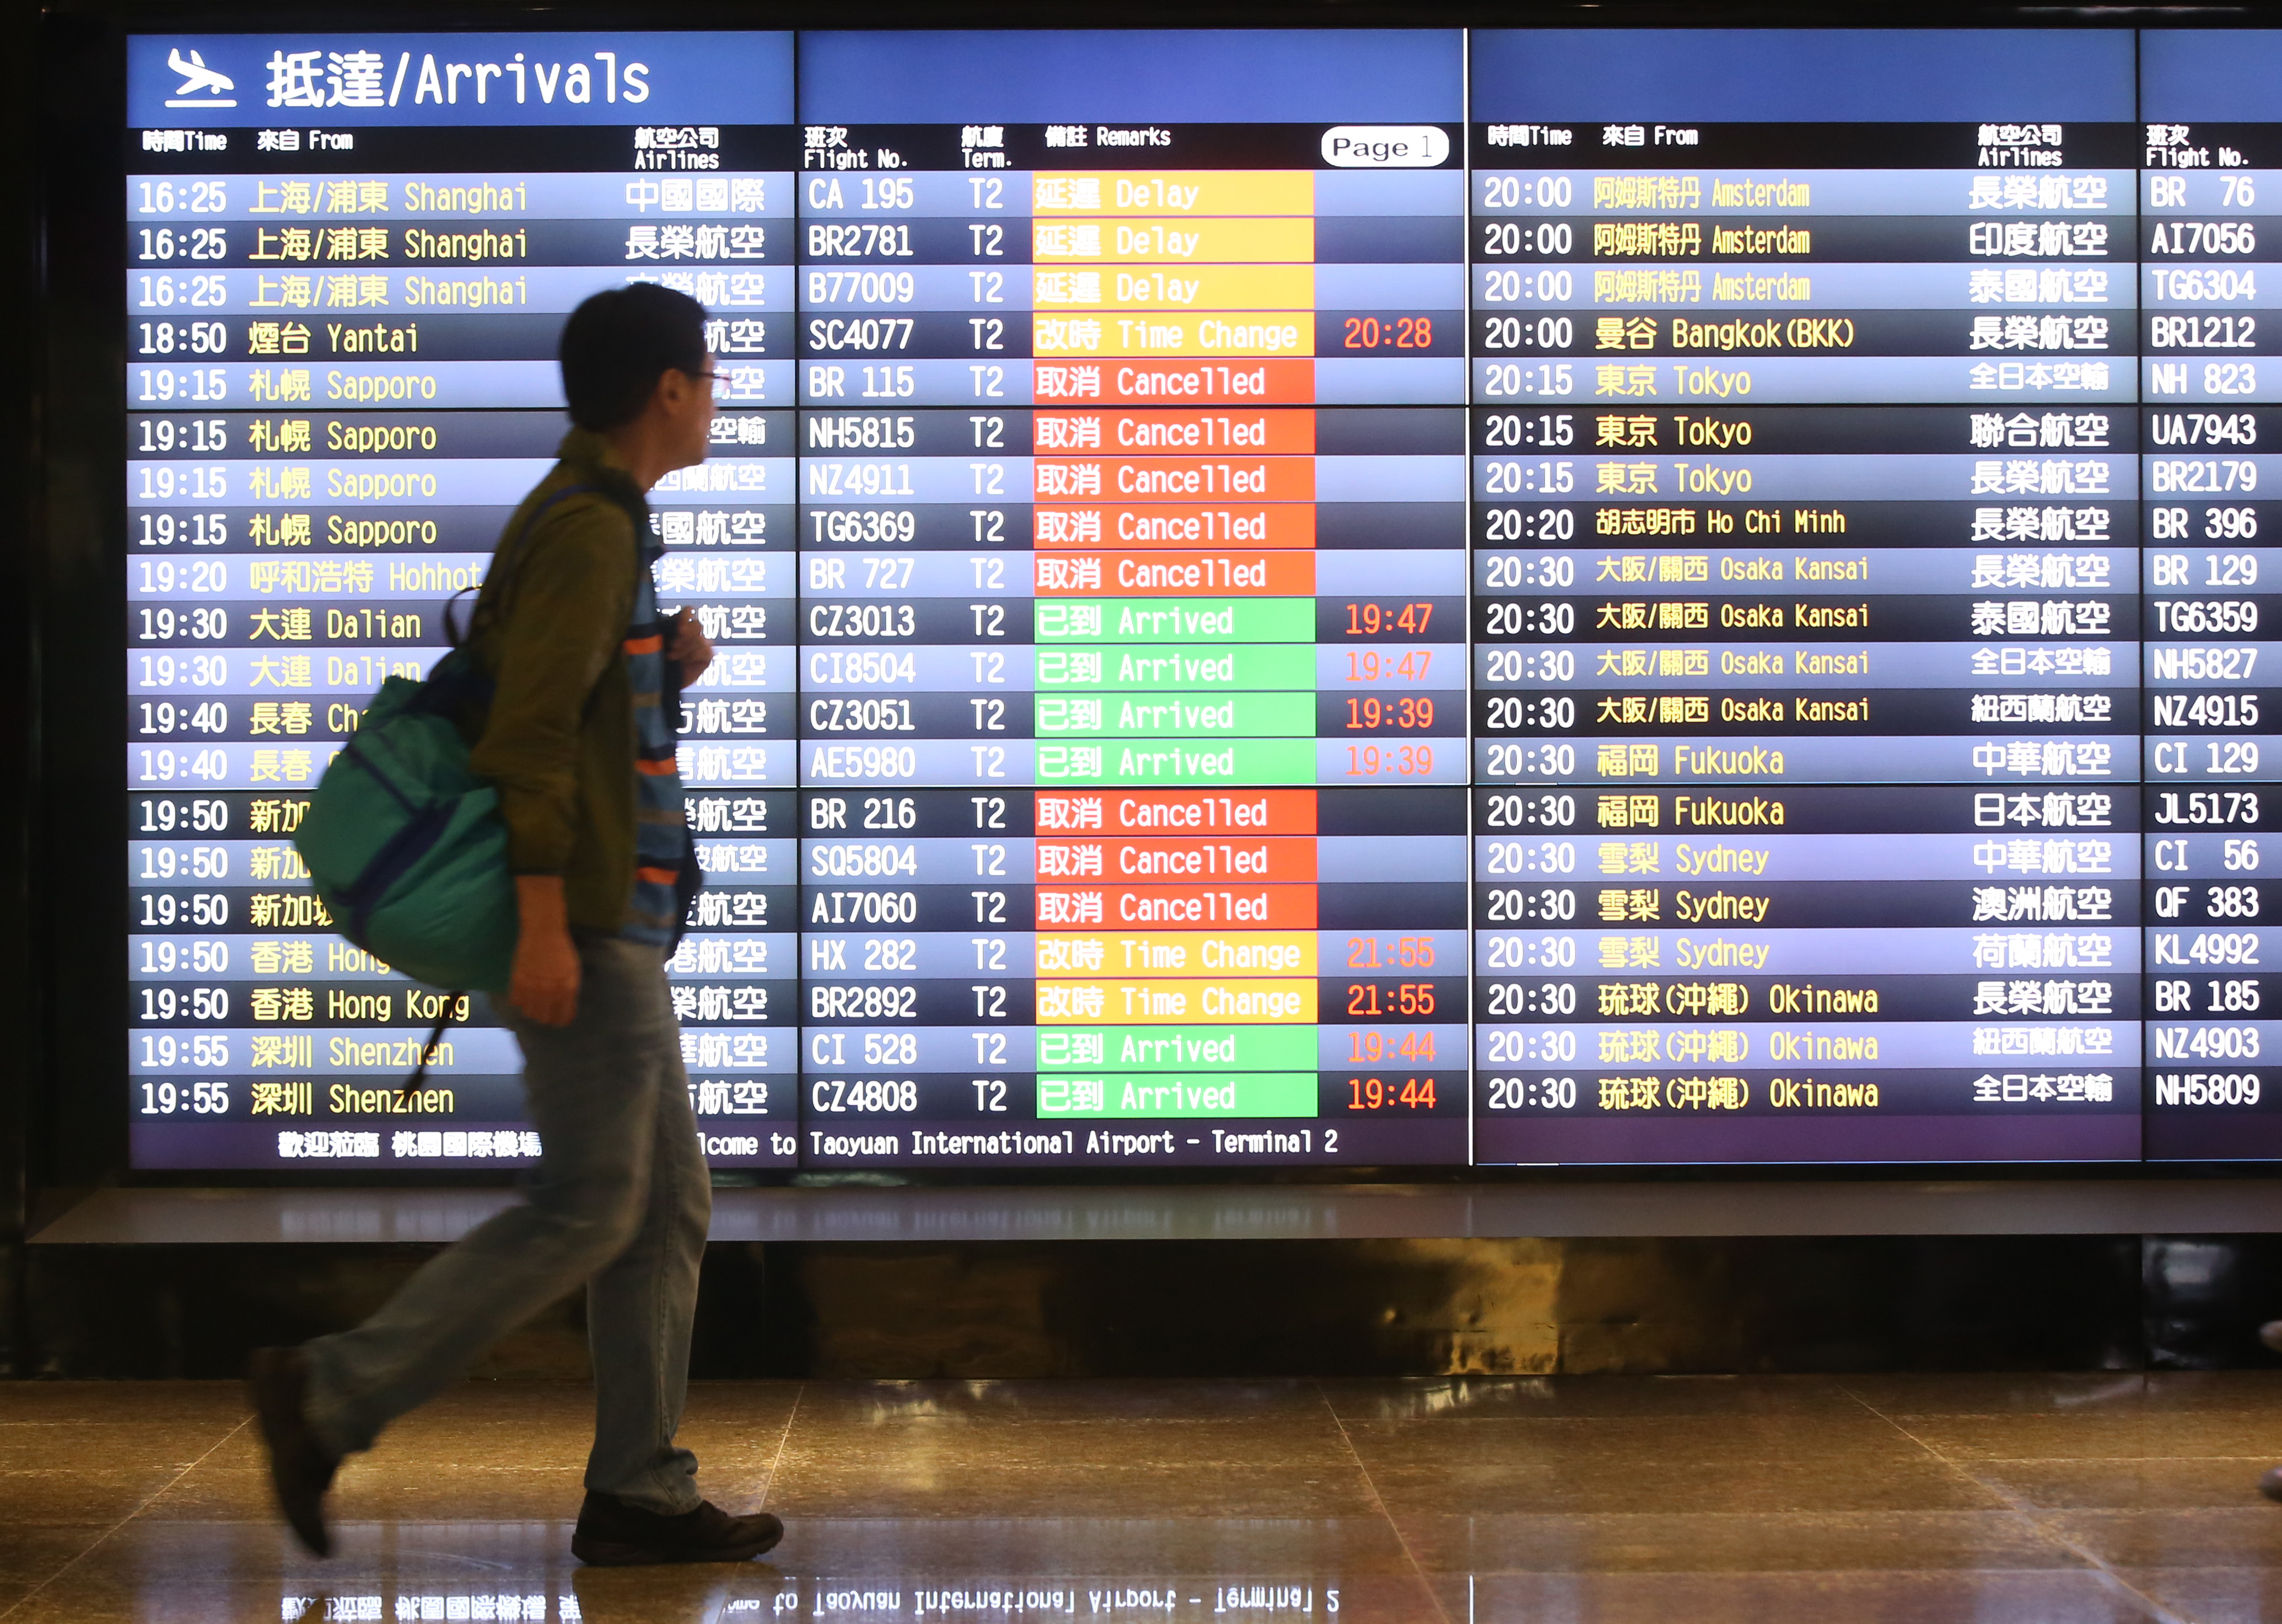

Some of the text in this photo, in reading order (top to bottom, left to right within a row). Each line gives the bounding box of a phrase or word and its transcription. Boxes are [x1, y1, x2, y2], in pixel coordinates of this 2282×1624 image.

[265, 49, 650, 109] 抵達/Arrivals
[256, 128, 300, 152] 來自
[309, 129, 354, 150] From
[633, 126, 719, 149] 航空公司
[804, 126, 848, 149] 班次
[1044, 124, 1171, 148] 備註 Remarks
[1333, 135, 1433, 162] Page 1
[1602, 123, 1645, 147] 來自
[1654, 125, 1699, 146] From
[1977, 124, 2063, 146] 航空公司
[2145, 124, 2190, 147] 班次
[634, 149, 720, 170] Airlines
[804, 148, 908, 171] Flight No.
[961, 147, 1012, 169] Term.
[1977, 146, 2063, 167] Airlines
[2146, 146, 2249, 169] Flight No.
[138, 176, 1201, 214] 16:25 上海/浦東 Shanghai 中國國際 CA 195 T2 延遲 Delay
[625, 223, 914, 260] 長榮航空 BR2781
[1484, 220, 2256, 257] 20:00 阿姆斯特丹 Amsterdam 印度航空 AI7056
[138, 320, 417, 355] 18:50 煙台 Yantai
[809, 316, 1433, 352] SC4077 T2 改時 Time Change 20:28
[1484, 316, 1573, 349] 20:00
[1595, 315, 1658, 350] 曼谷
[1969, 314, 2109, 351] 長榮航空
[2151, 315, 2256, 348] BR1212
[138, 418, 437, 454] 19:15 札幌 Sapporo
[809, 416, 1266, 449] NH5815 T2 取消 Cancelled
[1485, 411, 2257, 449] 20:15 東京 Tokyo 聯合航空 UA7943
[809, 510, 916, 542] TG6369
[1486, 506, 2258, 542] 20:20 胡志明市 Ho Chi Minh 長榮航空 BR 396
[249, 559, 481, 594] 呼和浩特 Hohhot
[139, 606, 421, 641] 19:30 大連 Dalian
[810, 602, 1434, 637] CZ3013 T2 已到 Arrived 19:47
[1486, 599, 2258, 636] 20:30 大阪/關西 Osaka Kansai 泰國航空 TG6359
[139, 700, 313, 735] 19:40 長春
[810, 696, 1435, 731] CZ3051 T2 已到 Arrived 19:39
[1970, 693, 2259, 727] 紐西蘭航空 NZ4915
[1487, 791, 2259, 829] 20:30 福岡 Fukuoka 日本航空 JL5173
[1487, 885, 2260, 923] 20:30 雪梨 Sydney 澳洲航空 QF 383
[140, 987, 229, 1020] 19:50
[250, 987, 314, 1021] 香港
[328, 989, 392, 1023] Hong
[811, 983, 1436, 1019] BR2892 T2 改時 Time Change 21:55
[1488, 982, 1576, 1015] 20:30
[1769, 983, 1879, 1014] Okinawa
[1972, 978, 2113, 1015] 長榮航空
[2155, 980, 2192, 1012] BR
[2207, 979, 2261, 1012] 185
[141, 1082, 229, 1115] 19:55
[250, 1081, 313, 1116] 深圳
[812, 1077, 1438, 1112] CZ4808 T2 已到 Arrived 19:44
[1972, 1072, 2261, 1106] 全日本空輸 NH5809
[277, 1130, 380, 1159] 歡迎蒞臨
[391, 1130, 542, 1158] 桃園國際機場
[696, 1131, 759, 1156] lcome
[769, 1131, 797, 1155] to
[809, 1131, 899, 1158] Taoyuan
[911, 1130, 1073, 1155] International
[1086, 1130, 1176, 1157] Airport
[1211, 1129, 1311, 1154] Terminal
[1324, 1128, 1338, 1153] 2
